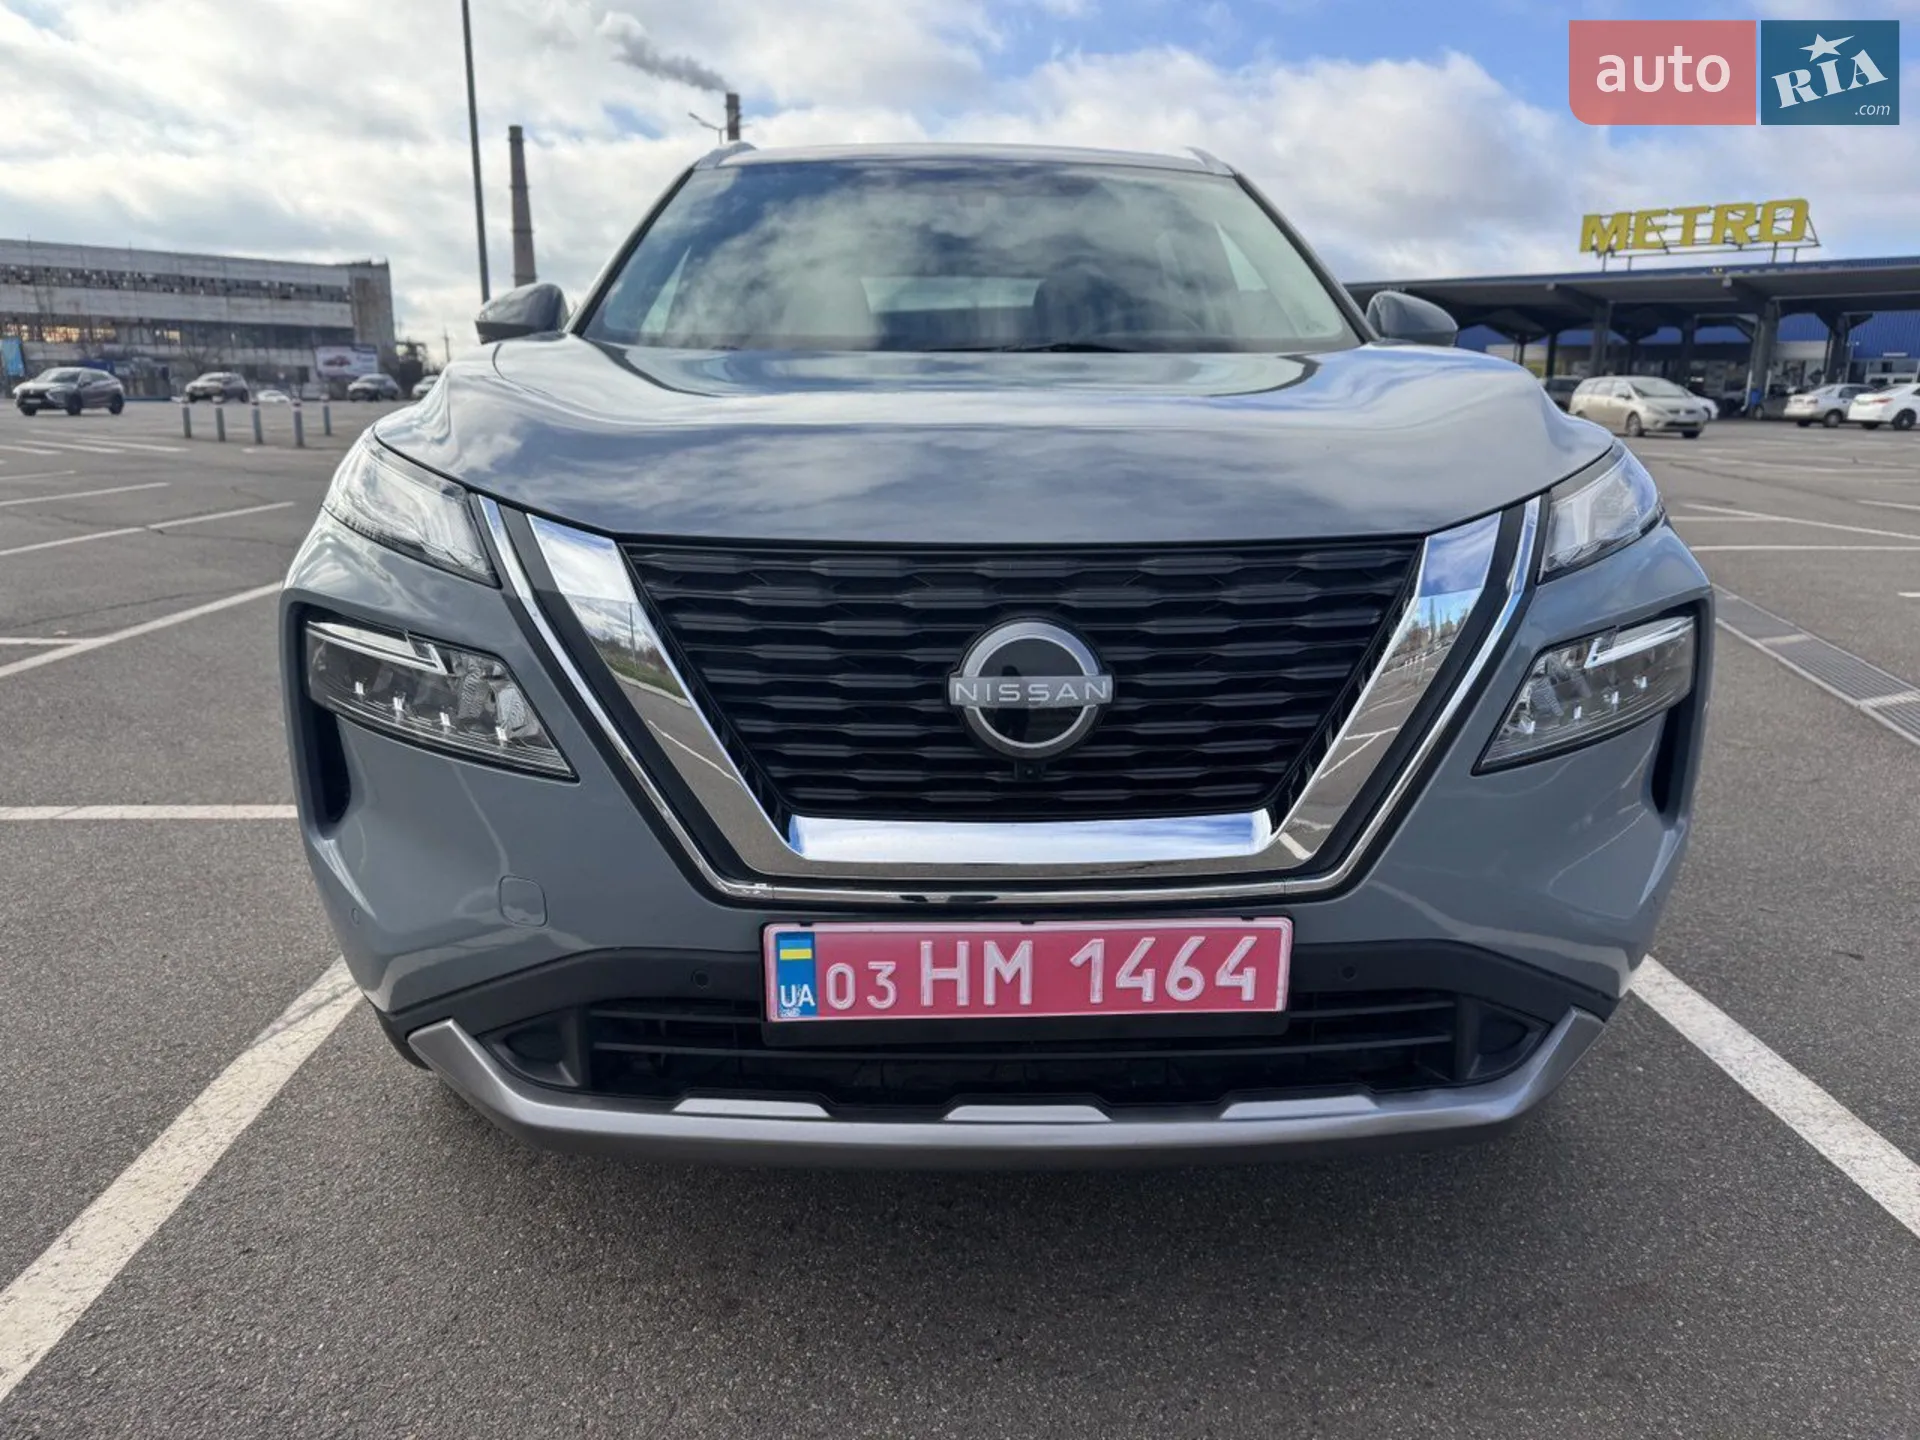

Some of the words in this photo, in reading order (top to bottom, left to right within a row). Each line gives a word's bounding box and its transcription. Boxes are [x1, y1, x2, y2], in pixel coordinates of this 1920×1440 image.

[1580, 198, 1809, 253] METRO
[955, 682, 1106, 701] NISSAN
[826, 961, 896, 1010] 03
[920, 940, 1033, 1006] HM
[1069, 936, 1258, 1004] 1464
[780, 984, 816, 1007] UA
